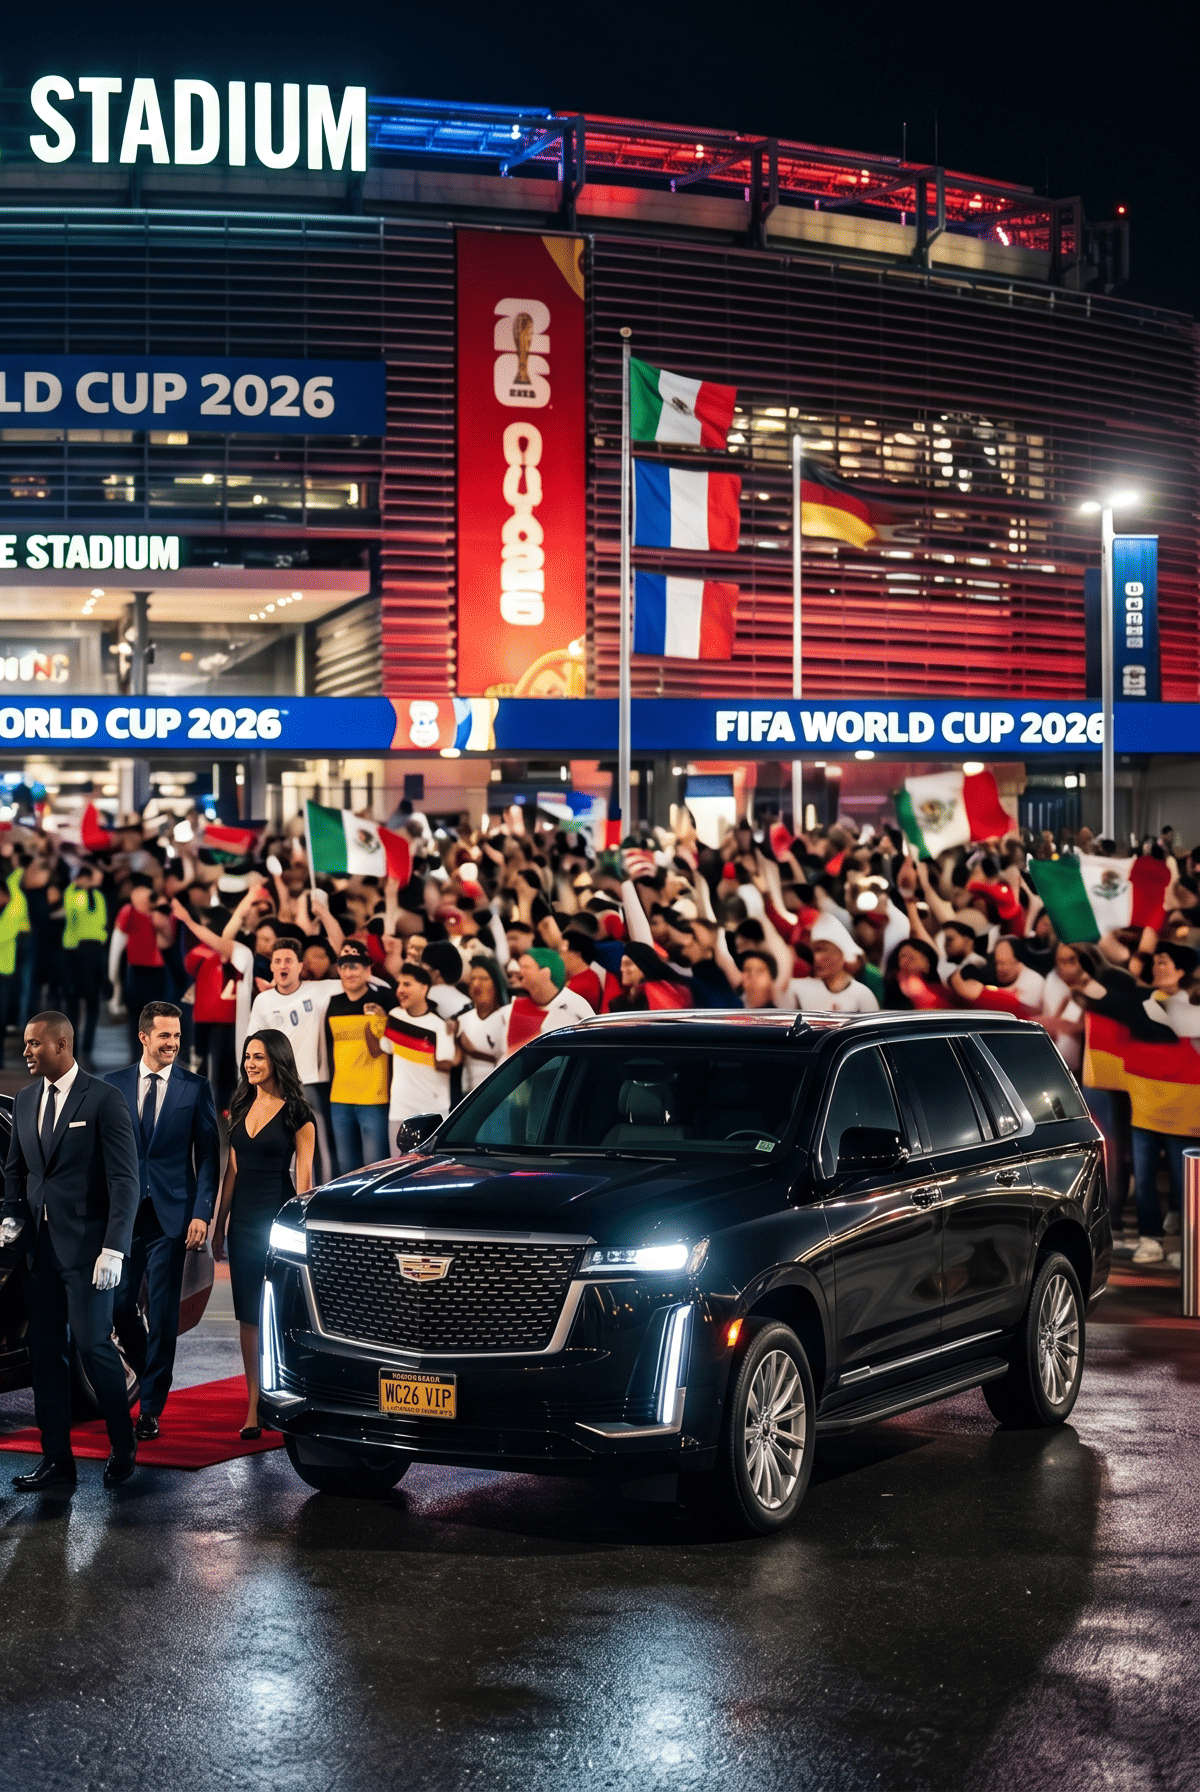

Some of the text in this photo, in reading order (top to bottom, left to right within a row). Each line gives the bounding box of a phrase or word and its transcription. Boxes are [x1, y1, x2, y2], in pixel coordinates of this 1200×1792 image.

[29, 74, 367, 172] STADIUM
[75, 371, 188, 415] CUP
[200, 373, 335, 418] 2026
[25, 534, 179, 571] STADIUM
[104, 707, 182, 740] CUP
[187, 707, 282, 740] 2026
[715, 710, 1105, 744] FIFA WORLD CUP 2026
[385, 1382, 452, 1408] WC26 VIP
